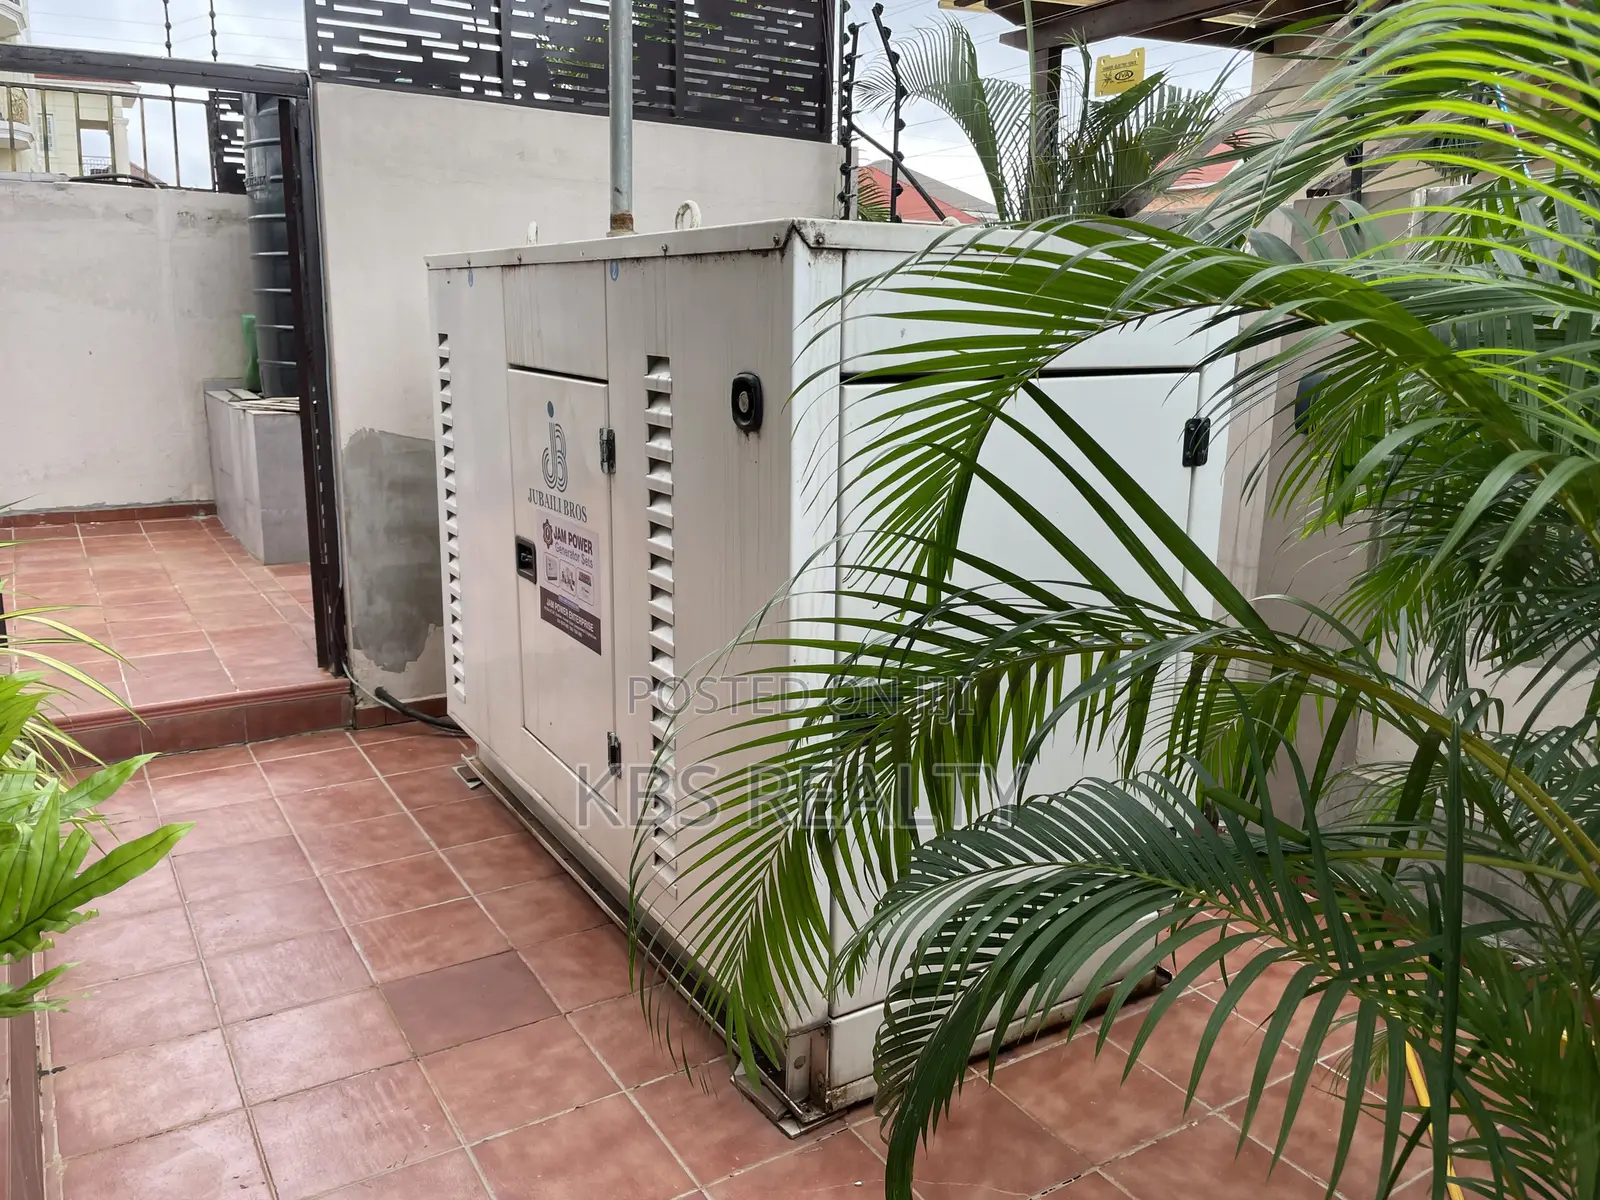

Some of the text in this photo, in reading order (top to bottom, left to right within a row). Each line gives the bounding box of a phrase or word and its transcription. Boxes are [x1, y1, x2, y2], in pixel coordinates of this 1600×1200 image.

[527, 488, 588, 523] JUBAILI BROS
[553, 525, 593, 556] JAM POWER
[554, 541, 594, 569] Generator Sets
[554, 602, 568, 618] POWER
[568, 610, 594, 633] ENTERPRISE
